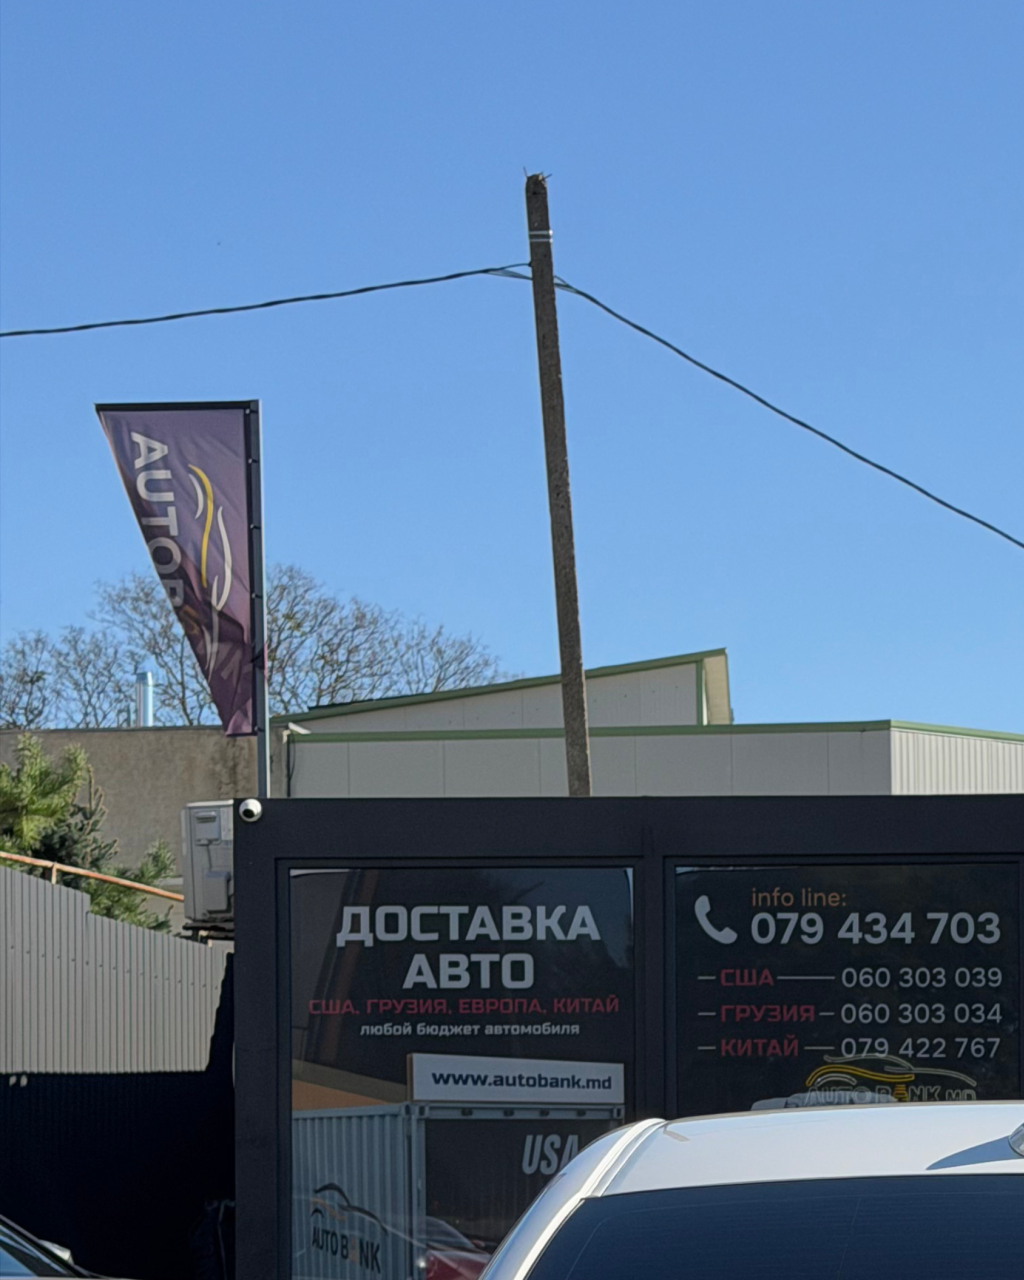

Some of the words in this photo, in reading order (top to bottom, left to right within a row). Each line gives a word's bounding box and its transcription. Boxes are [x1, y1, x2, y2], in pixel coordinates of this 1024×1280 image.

[751, 887, 795, 907] info
[802, 888, 847, 907] line:
[336, 905, 601, 948] ДОСТАВКА
[751, 912, 824, 944] 079
[838, 912, 915, 944] 434
[927, 912, 1001, 944] 703
[402, 953, 535, 989] АВТО
[720, 968, 774, 986] США
[841, 967, 891, 988] 060
[899, 967, 947, 988] 303
[954, 967, 1003, 988] 039
[553, 994, 620, 1014] КИТАЙ
[720, 1004, 816, 1022] ГРУЗИЯ
[840, 1003, 890, 1024] 060
[898, 1003, 946, 1024] 303
[954, 1003, 1002, 1024] 034
[360, 1022, 412, 1037] любой
[417, 1022, 481, 1038] бюджет
[485, 1021, 580, 1036] автомобиля
[720, 1033, 799, 1057] КИТАЙ
[840, 1037, 889, 1058] 079
[899, 1037, 947, 1058] 422
[955, 1037, 1001, 1058] 767
[432, 1071, 611, 1090] www.autobank.md
[312, 1226, 339, 1256] AUTO
